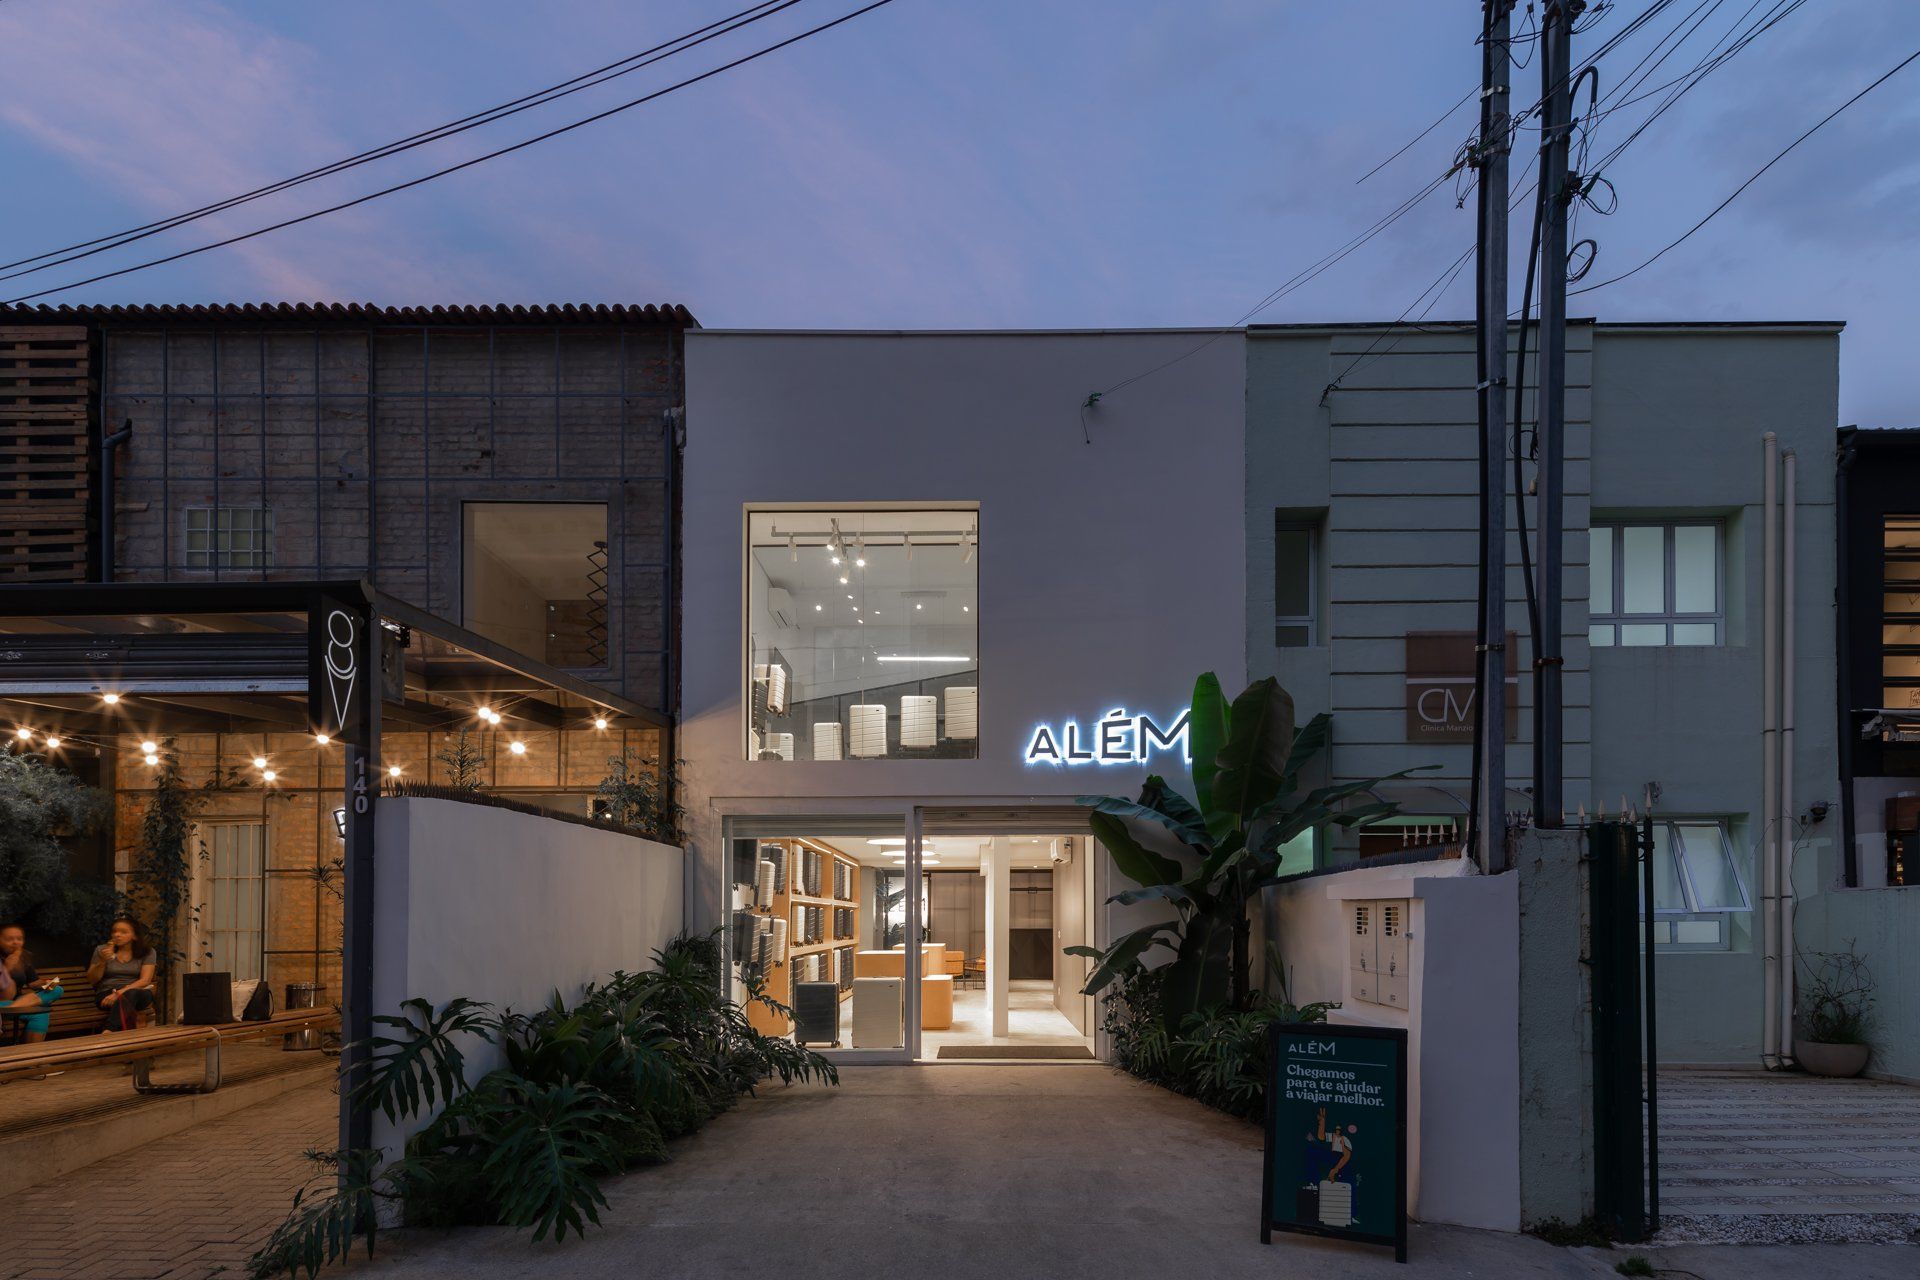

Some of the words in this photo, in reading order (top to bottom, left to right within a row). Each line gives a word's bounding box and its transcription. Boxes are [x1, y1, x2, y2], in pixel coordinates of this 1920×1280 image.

[1028, 709, 1192, 758] ALÉM
[353, 757, 368, 813] 140
[1288, 1041, 1335, 1055] ALÉM
[1286, 1064, 1356, 1080] Chegamos
[1286, 1079, 1316, 1089] para
[1320, 1080, 1333, 1090] te
[1336, 1081, 1381, 1095] ajudar
[1286, 1090, 1294, 1099] a
[1296, 1089, 1332, 1103] viajar
[1334, 1093, 1385, 1106] melhor.
